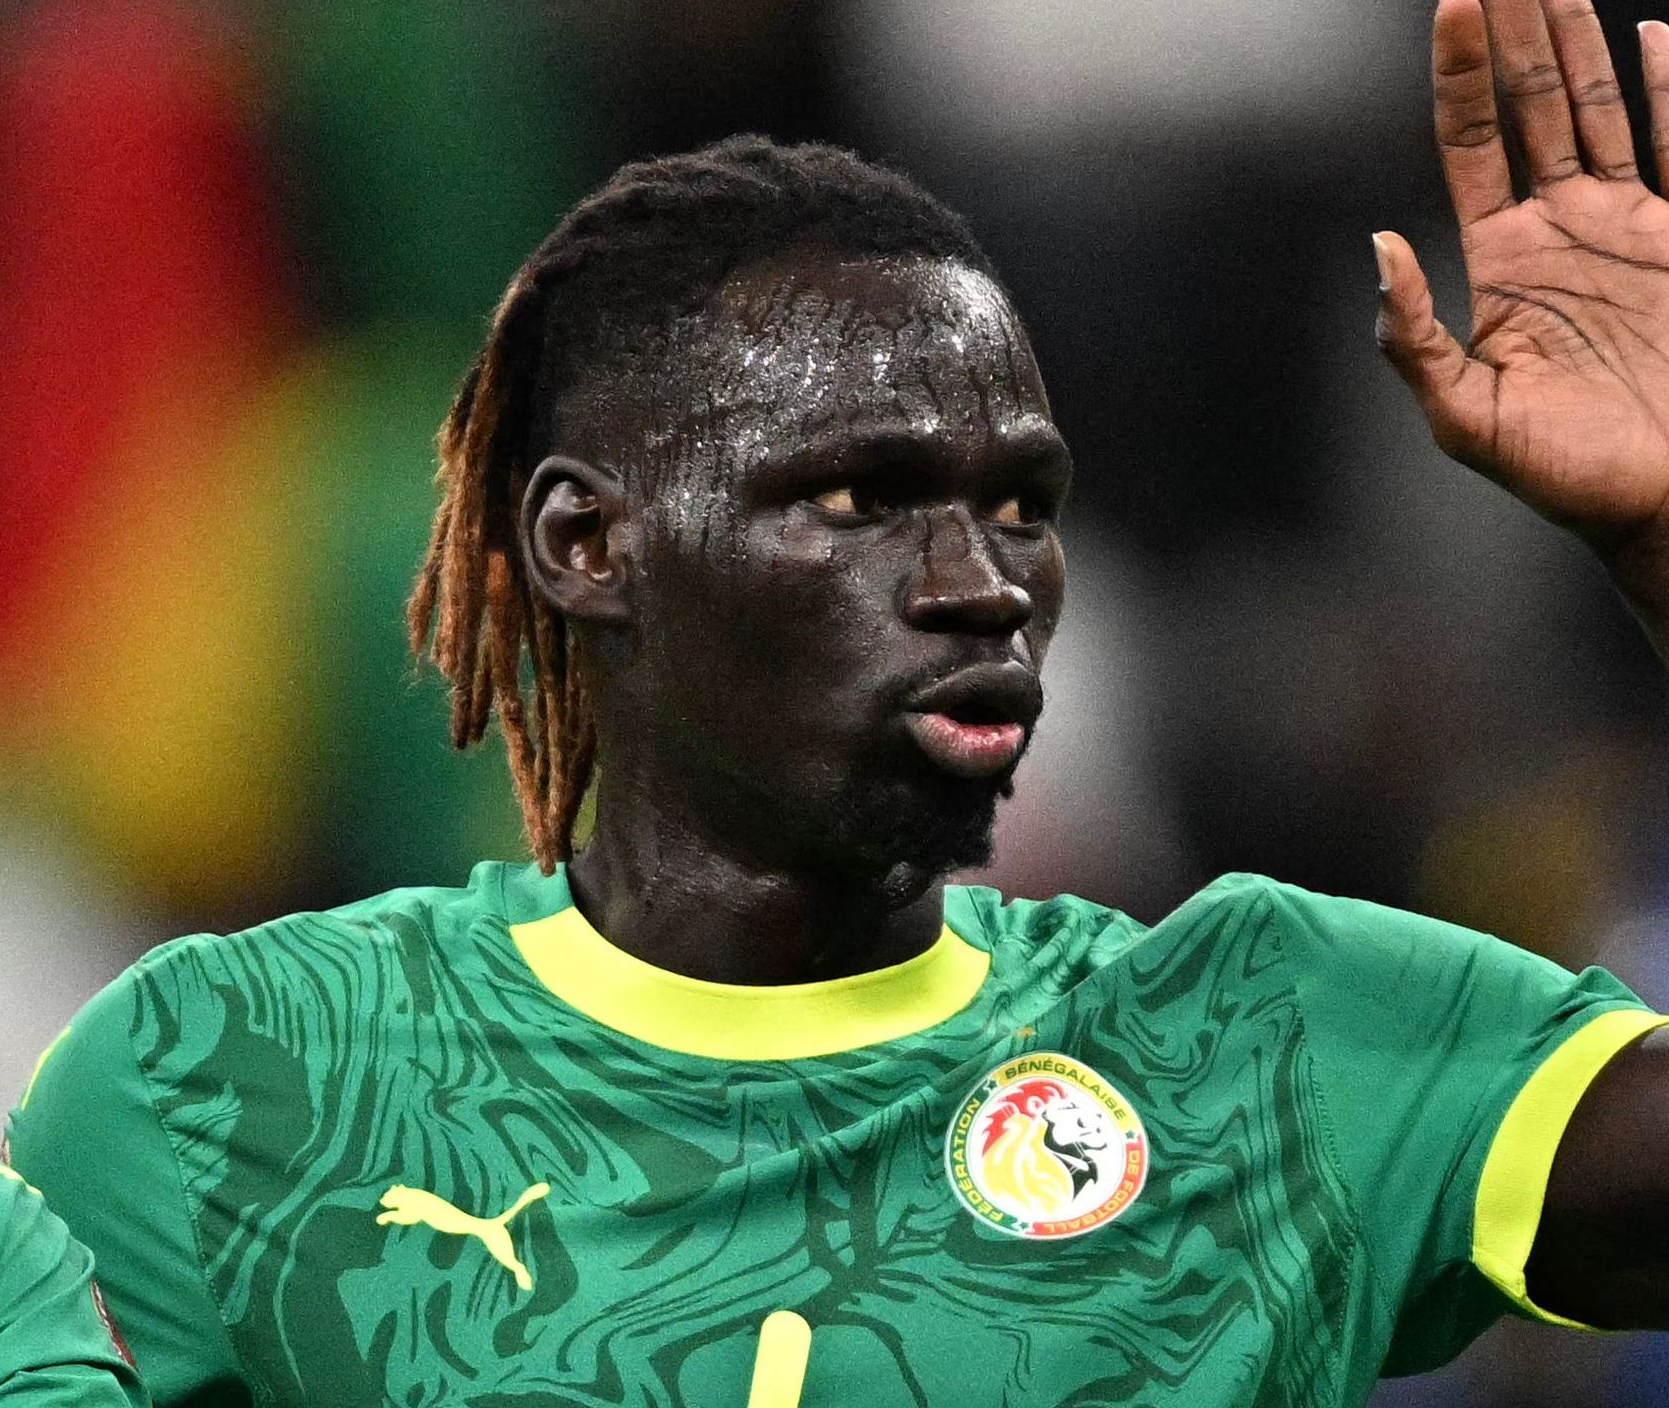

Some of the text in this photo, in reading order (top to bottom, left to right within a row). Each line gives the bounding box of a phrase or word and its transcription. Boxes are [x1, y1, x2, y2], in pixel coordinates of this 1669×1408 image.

[952, 1057, 1140, 1233] FÉDÉRATION SÉNÉGALAISE DE FOOTBALL
